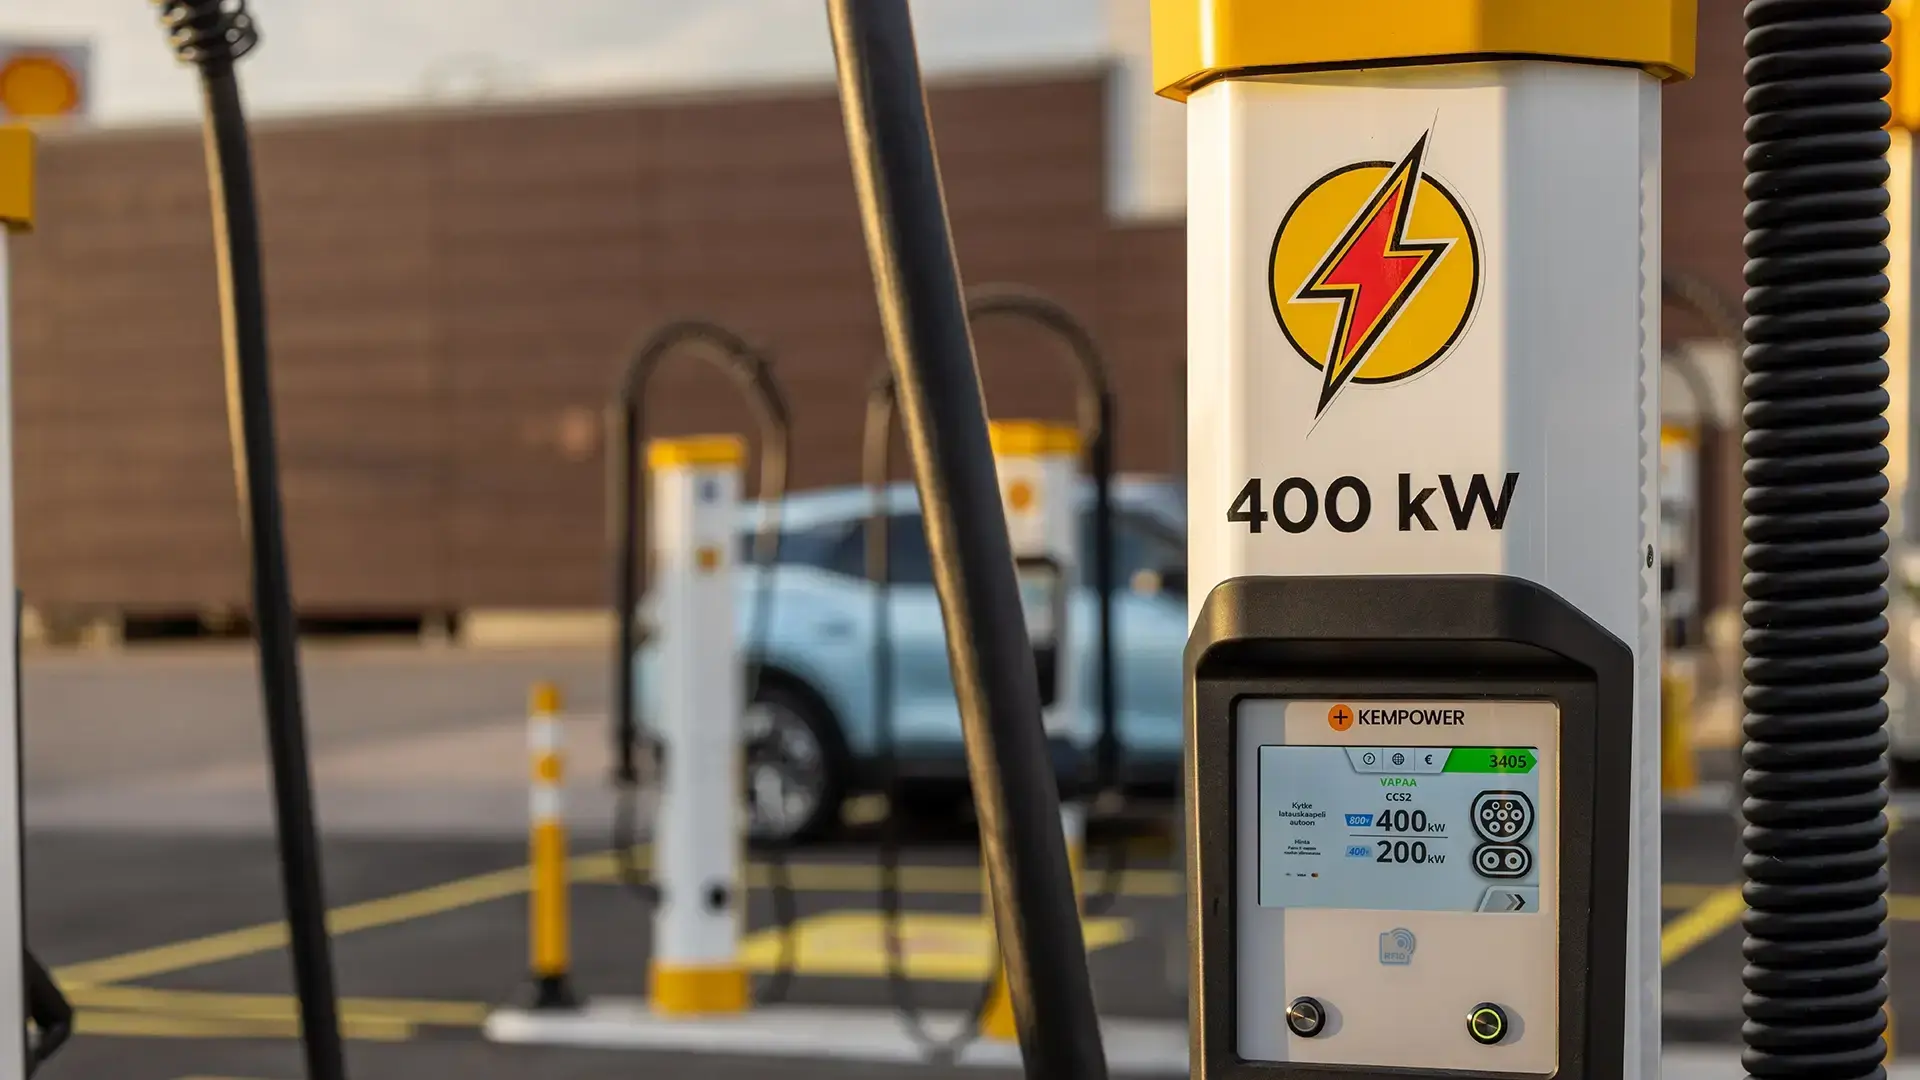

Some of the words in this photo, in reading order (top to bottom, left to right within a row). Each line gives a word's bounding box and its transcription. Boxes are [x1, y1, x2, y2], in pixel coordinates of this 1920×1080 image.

[1227, 475, 1372, 534] 400
[1398, 472, 1520, 531] kW
[1358, 709, 1465, 725] KEMPOWER
[1489, 754, 1527, 768] 3405
[1380, 778, 1417, 787] VAPAA
[1385, 792, 1412, 801] CCS2
[1292, 802, 1313, 810] Kytke
[1278, 810, 1327, 819] latauskaapeli
